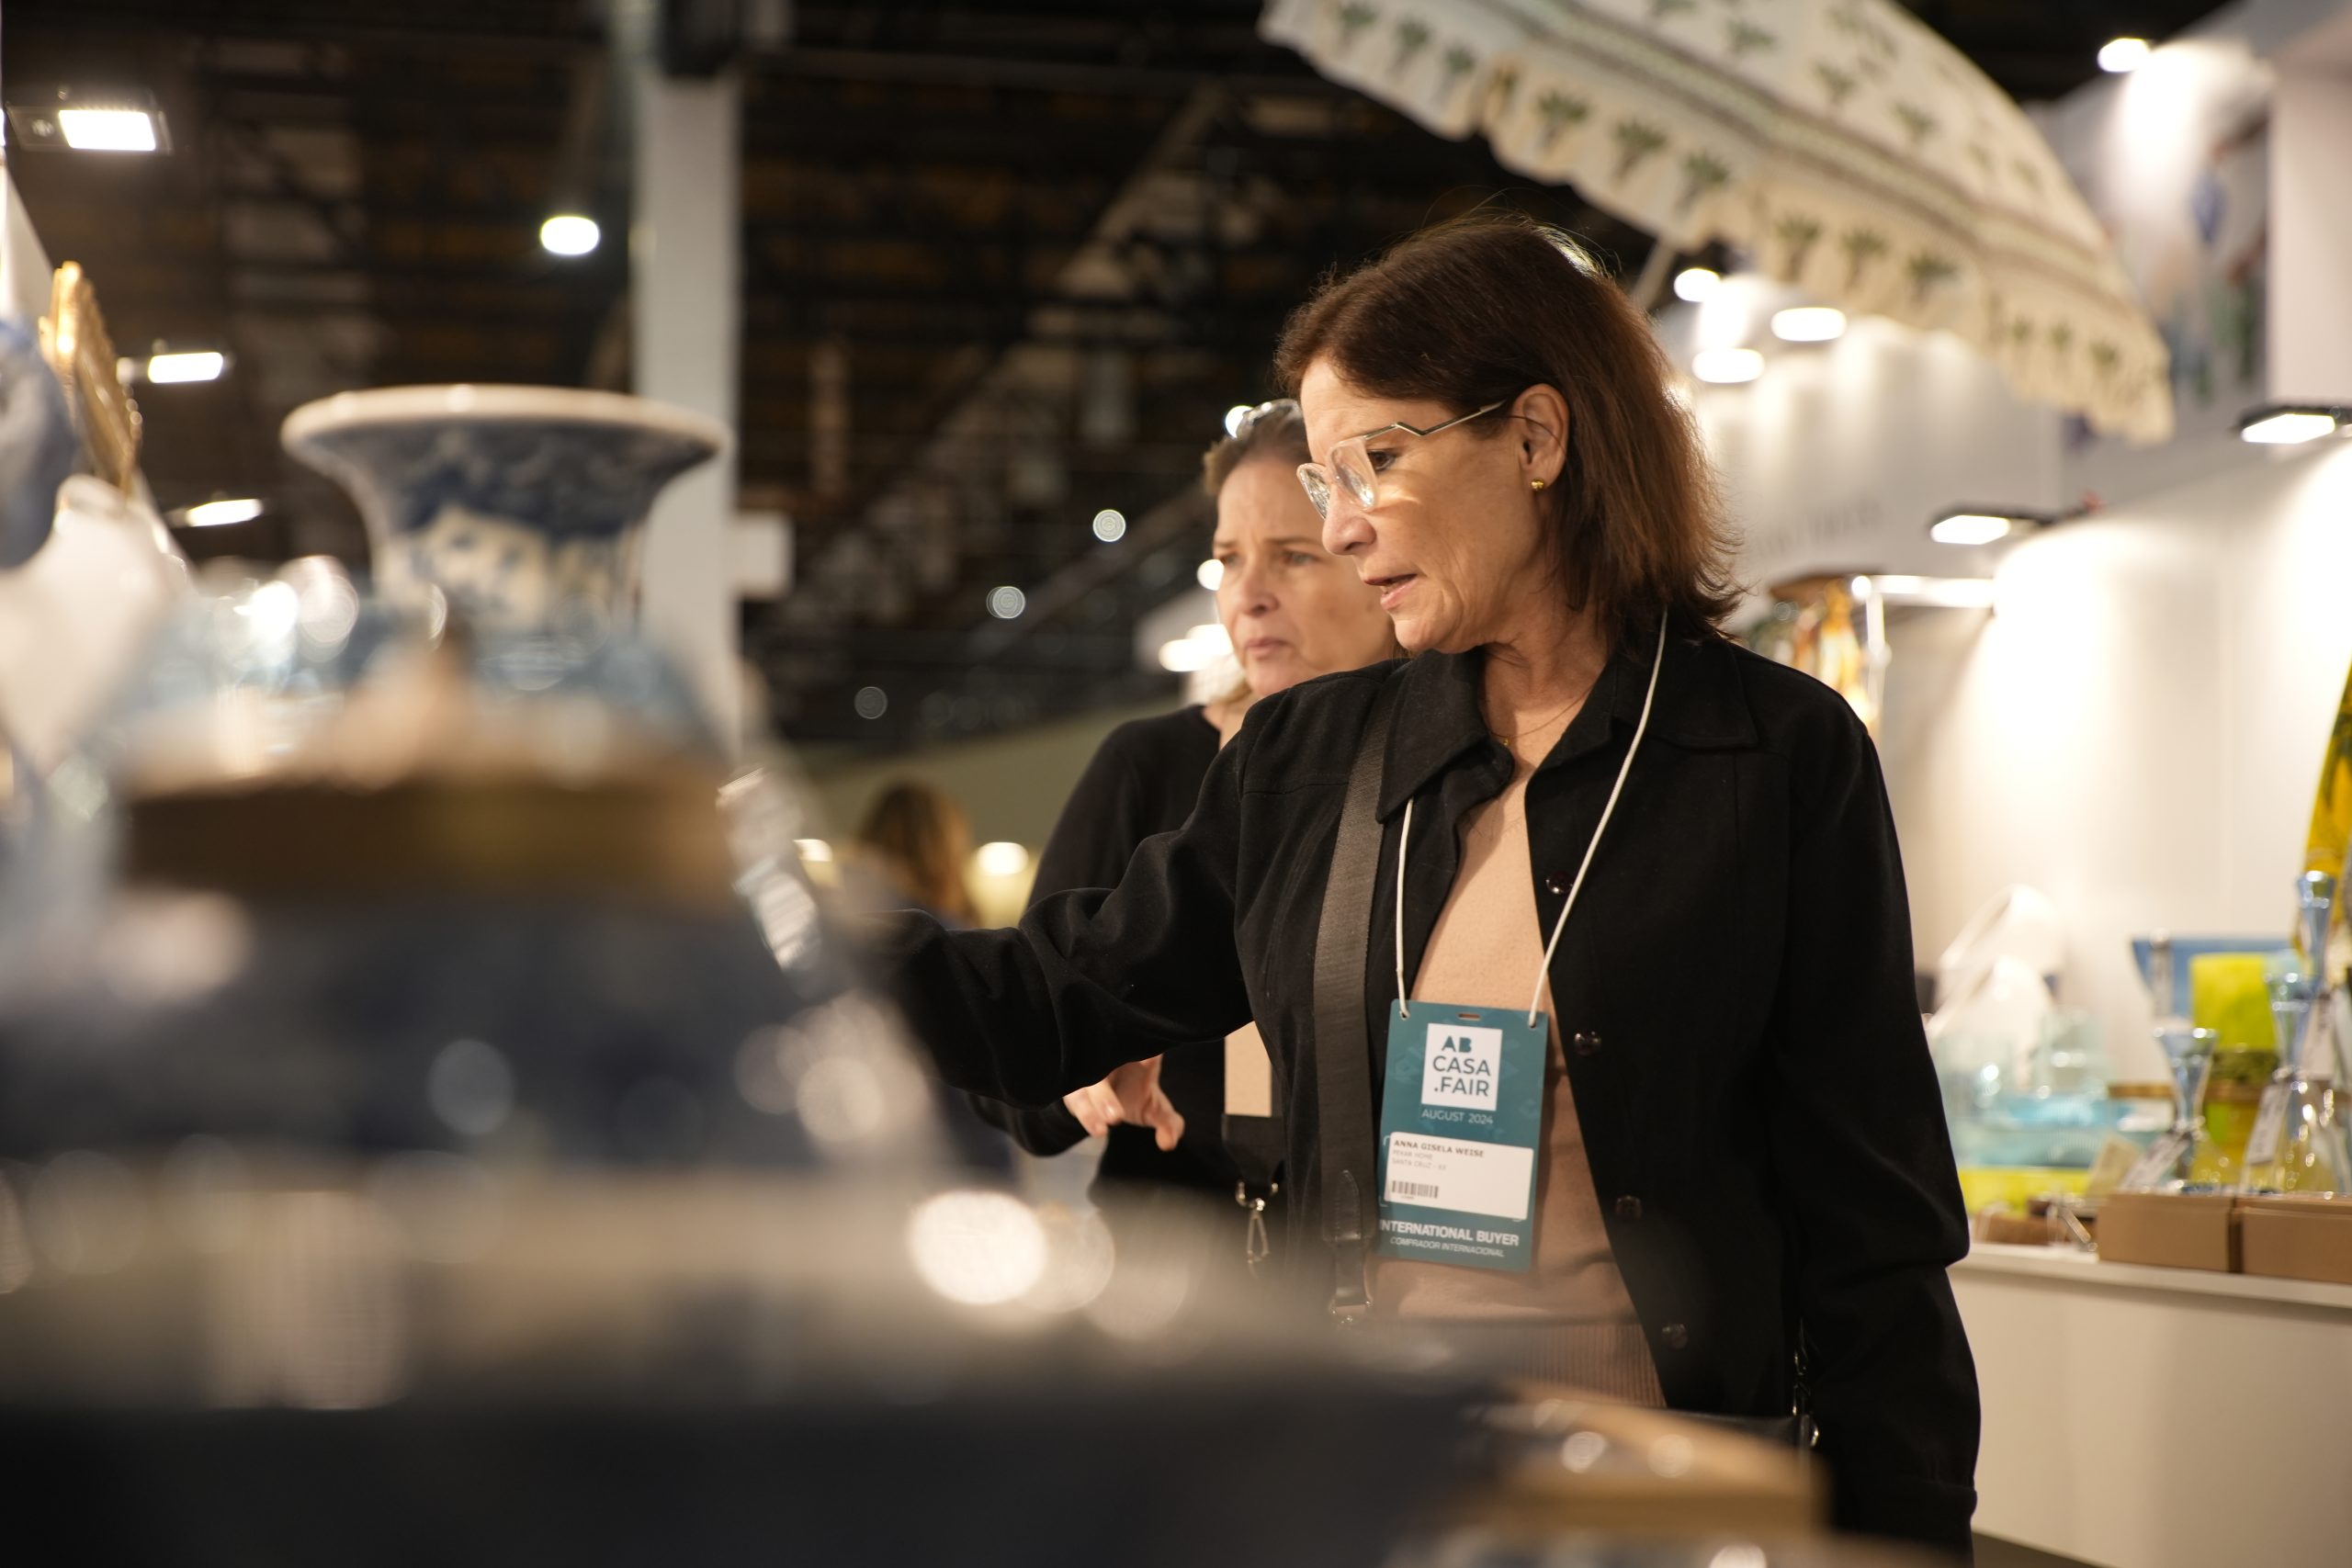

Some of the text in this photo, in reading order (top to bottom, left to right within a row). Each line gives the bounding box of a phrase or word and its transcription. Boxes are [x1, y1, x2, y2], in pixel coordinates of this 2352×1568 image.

[1442, 1035, 1473, 1054] AB
[1432, 1055, 1491, 1077] CASA
[1433, 1077, 1490, 1097] .FAIR
[1421, 1109, 1494, 1125] AUGUST 2024
[1394, 1139, 1484, 1157] ANNA GISELA WEISE
[1390, 1236, 1505, 1258] COMPRADOR INTERNACIONAL
[1476, 1230, 1520, 1247] BUYER
